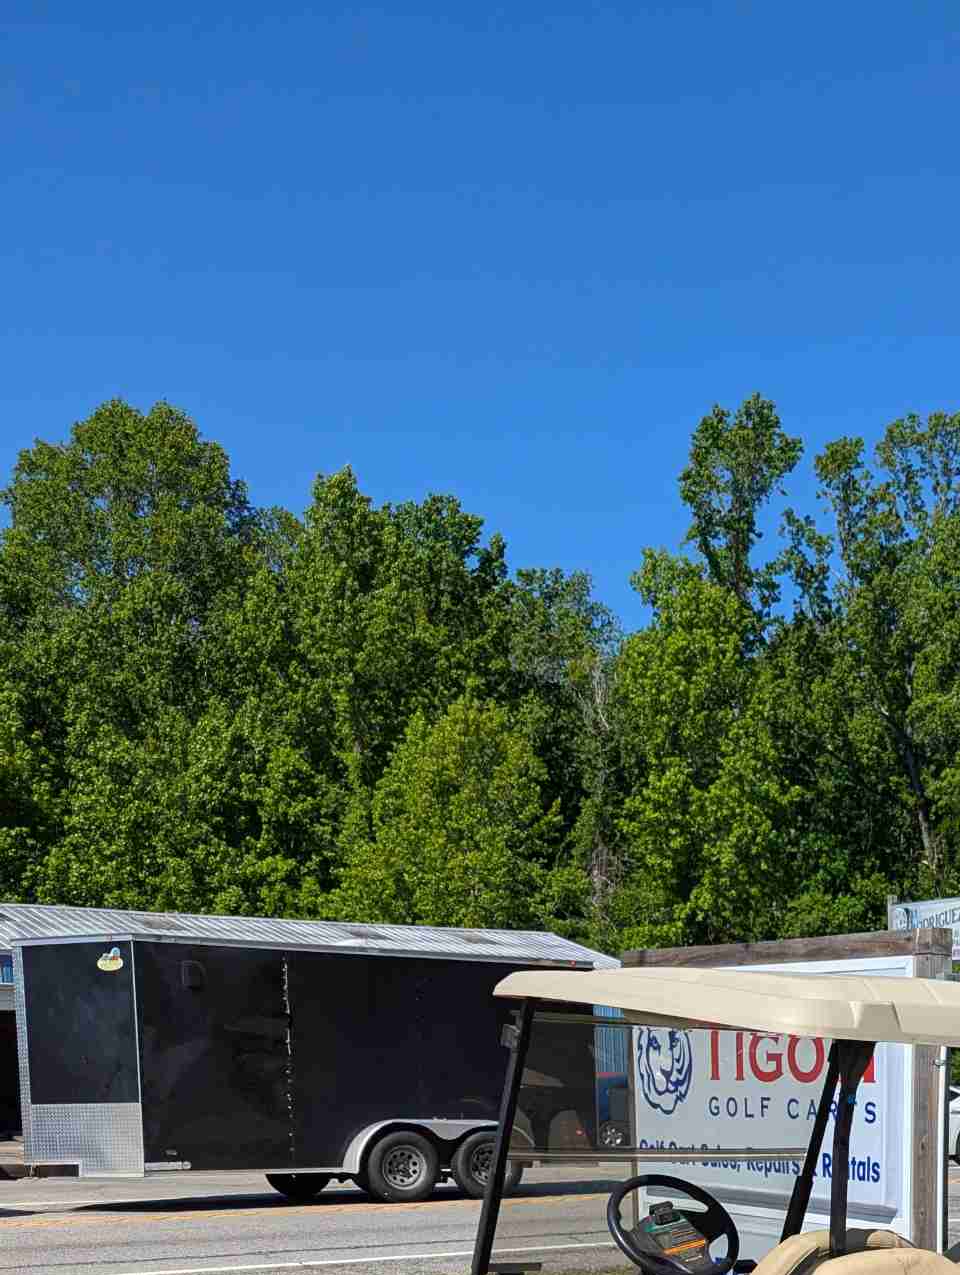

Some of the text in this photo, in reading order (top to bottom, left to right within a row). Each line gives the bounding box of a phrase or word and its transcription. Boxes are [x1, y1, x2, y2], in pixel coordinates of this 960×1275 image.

[710, 1030, 876, 1083] TIGO
[709, 1096, 877, 1124] GOLF CARS
[822, 1152, 881, 1183] Rtals
